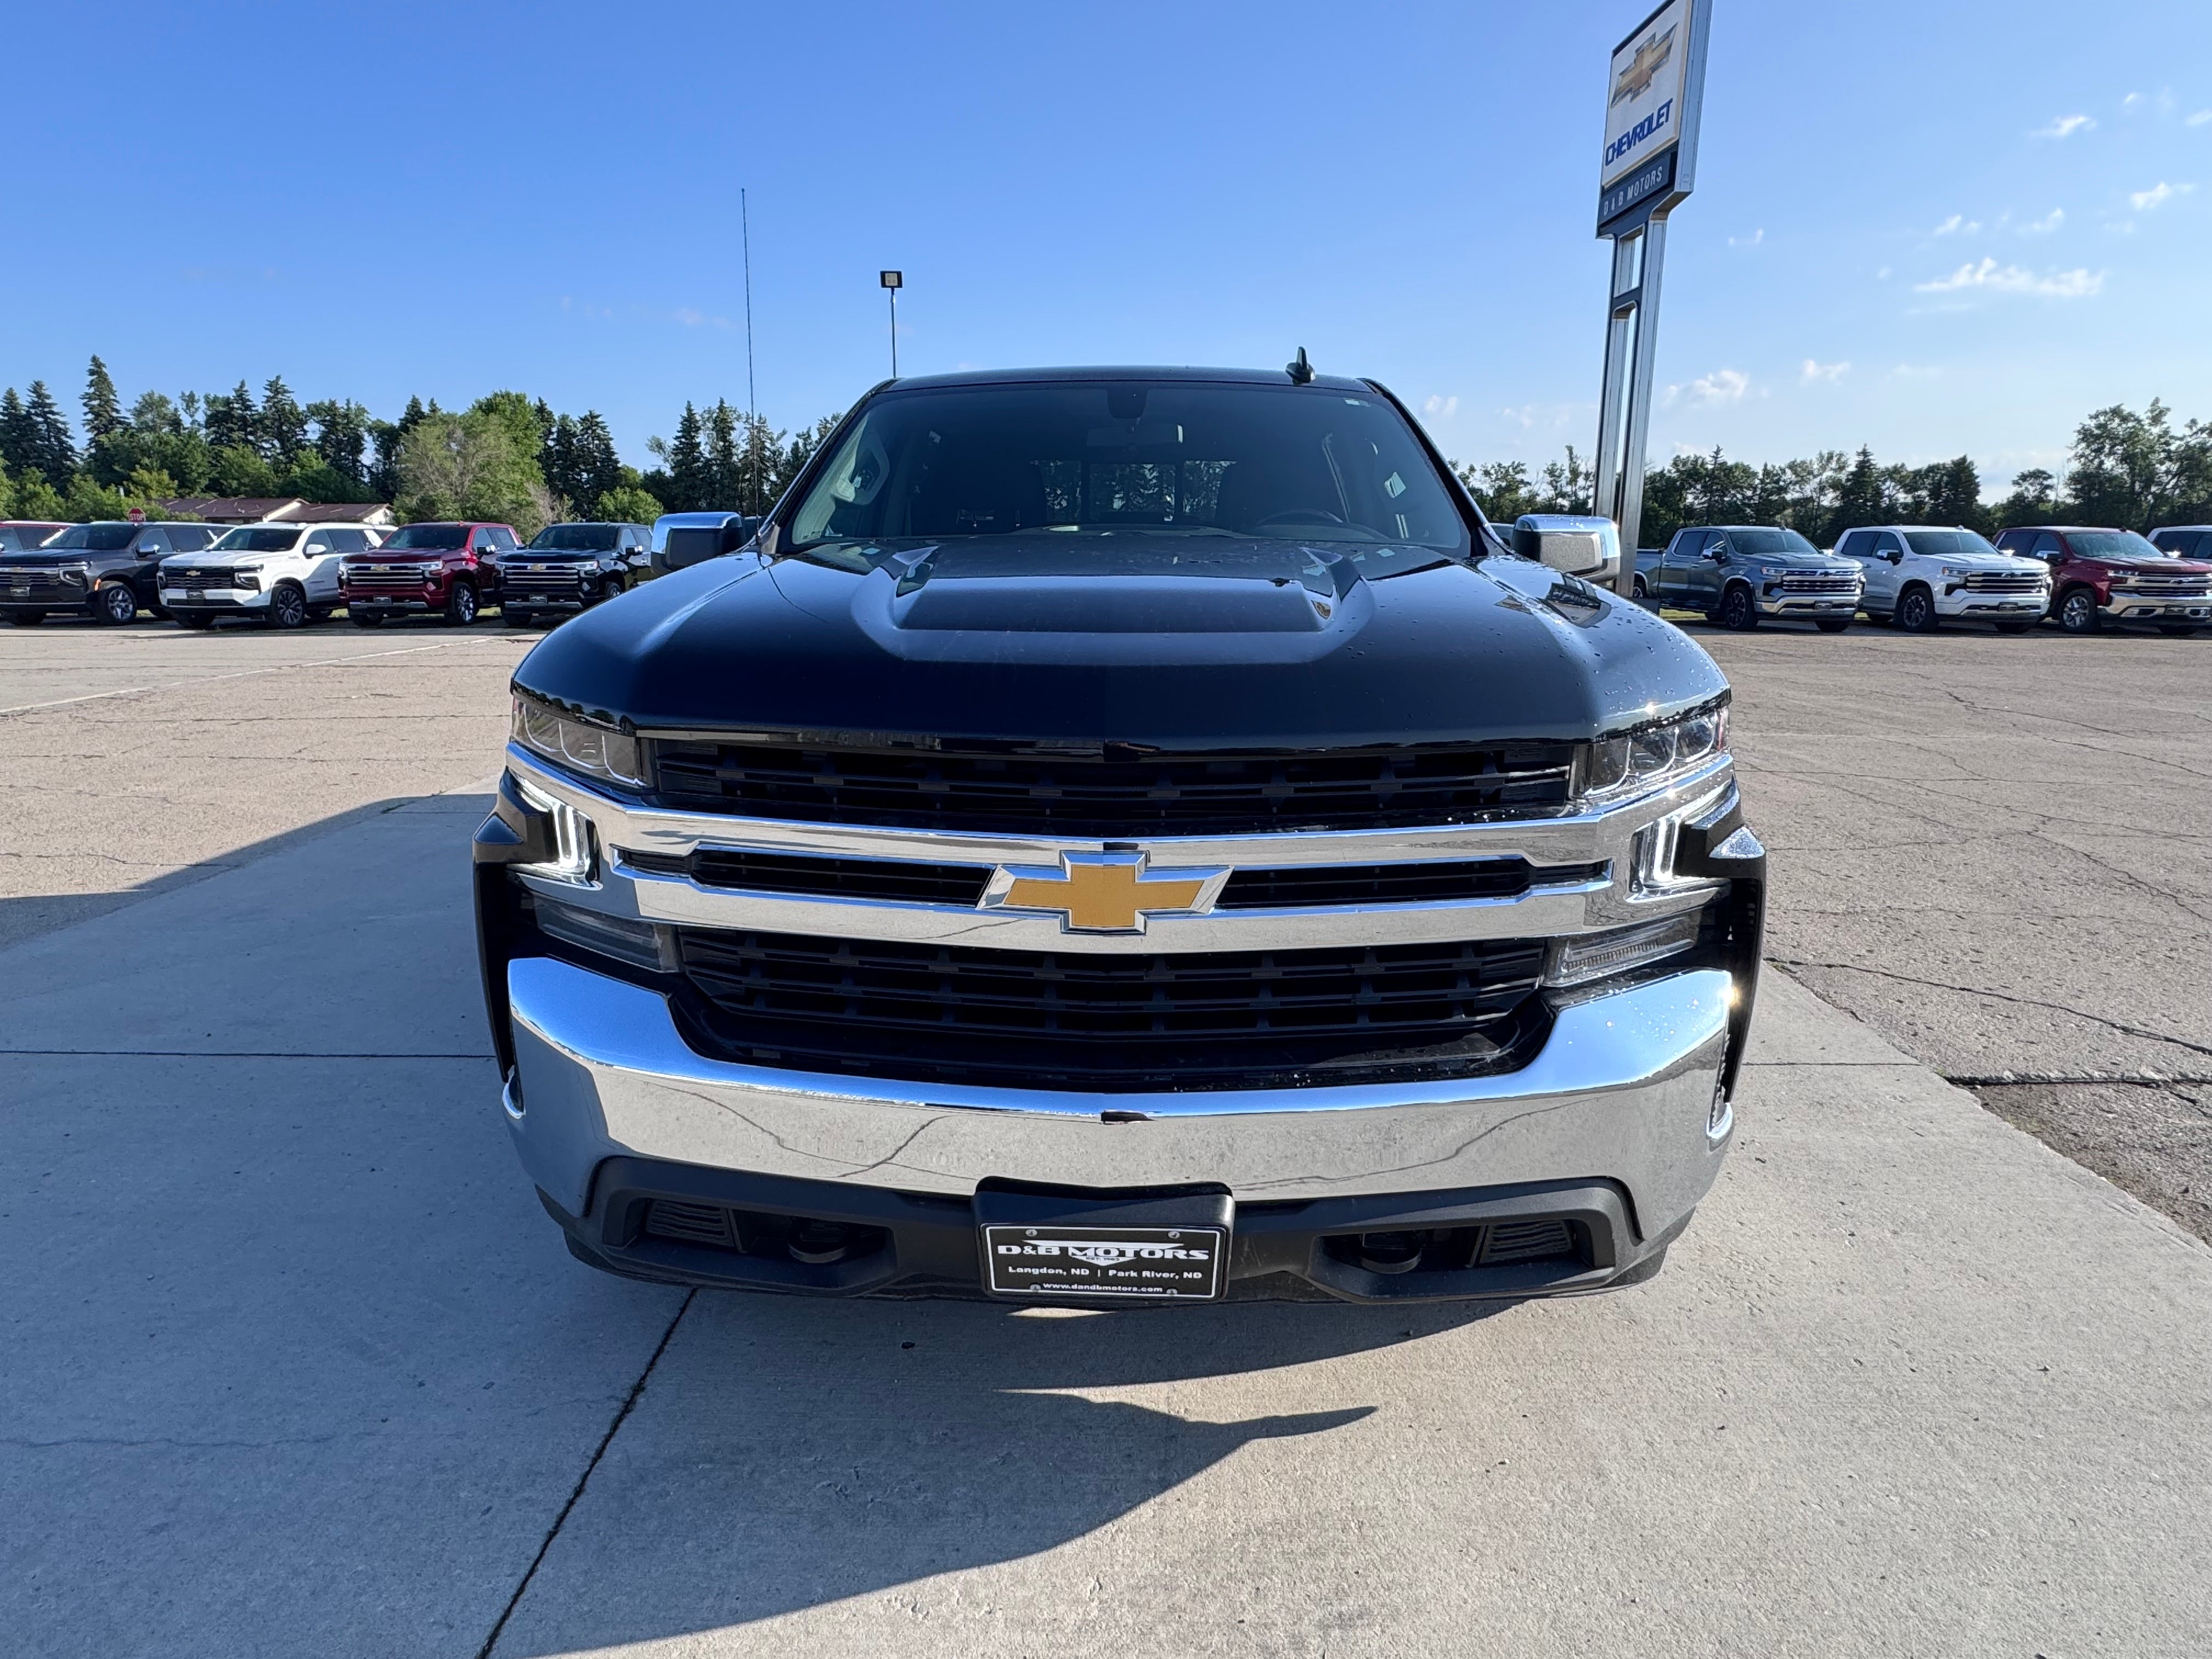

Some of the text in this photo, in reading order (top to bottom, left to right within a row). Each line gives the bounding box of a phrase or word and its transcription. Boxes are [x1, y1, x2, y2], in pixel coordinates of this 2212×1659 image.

[1605, 98, 1673, 166] CHEVROLET
[1604, 201, 1609, 216] D
[1618, 191, 1623, 206] B
[1627, 166, 1662, 201] MOTORS
[129, 513, 145, 521] STOP
[997, 1245, 1209, 1260] D&B MOTORS
[1008, 1266, 1066, 1276] Langdon,
[1142, 1271, 1179, 1279] River,
[1043, 1283, 1163, 1292] www.dandbmotors.com
